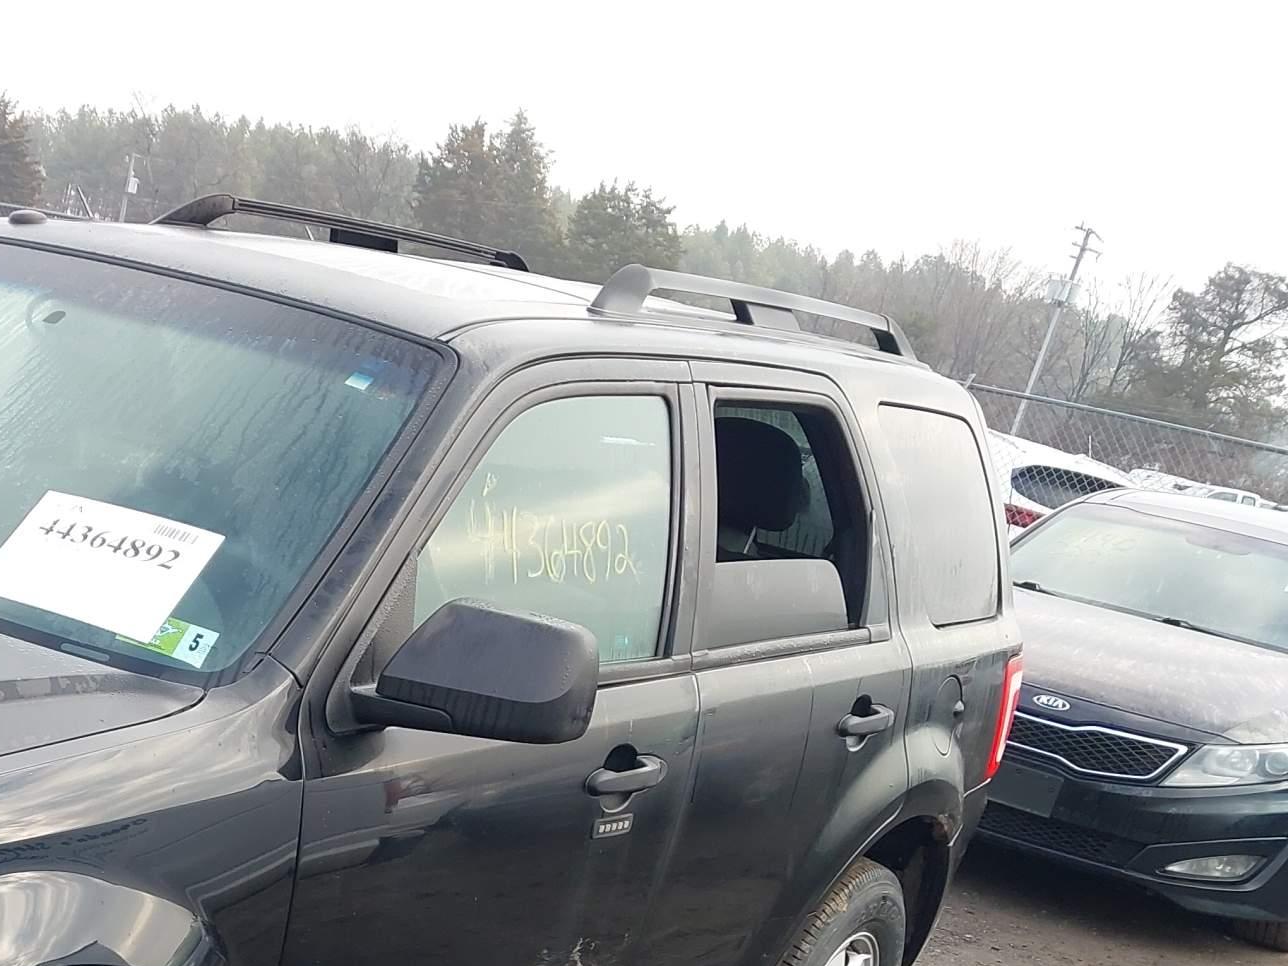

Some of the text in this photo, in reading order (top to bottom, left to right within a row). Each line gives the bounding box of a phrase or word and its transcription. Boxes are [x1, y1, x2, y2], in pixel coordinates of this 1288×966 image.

[39, 518, 181, 570] 44364892
[468, 499, 642, 584] 44364892
[188, 633, 204, 652] 5
